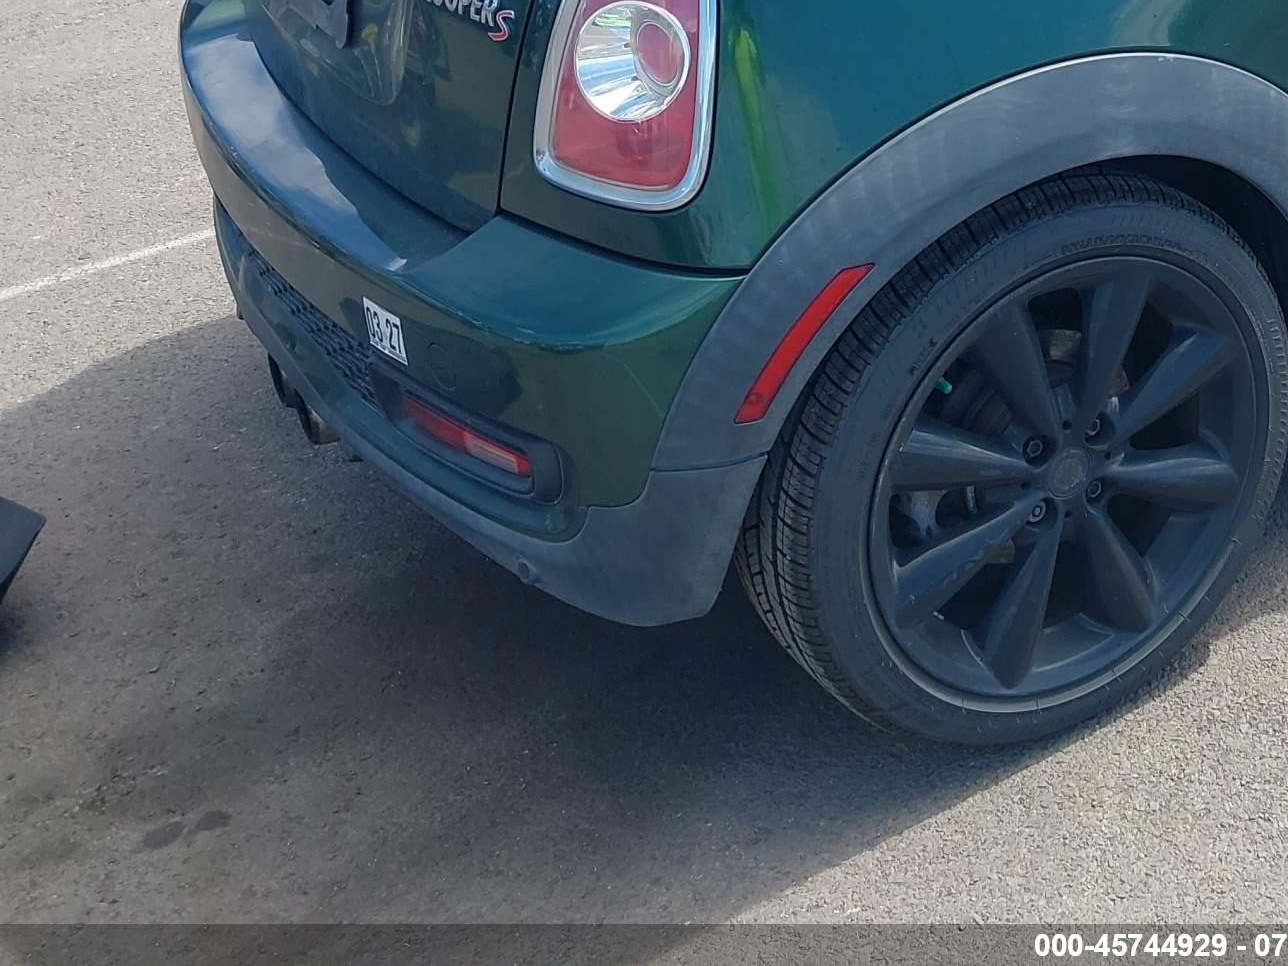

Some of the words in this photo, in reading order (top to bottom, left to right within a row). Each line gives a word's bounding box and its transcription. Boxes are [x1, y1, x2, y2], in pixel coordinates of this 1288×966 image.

[488, 9, 515, 41] S
[366, 305, 383, 343] 03
[385, 318, 402, 355] 27
